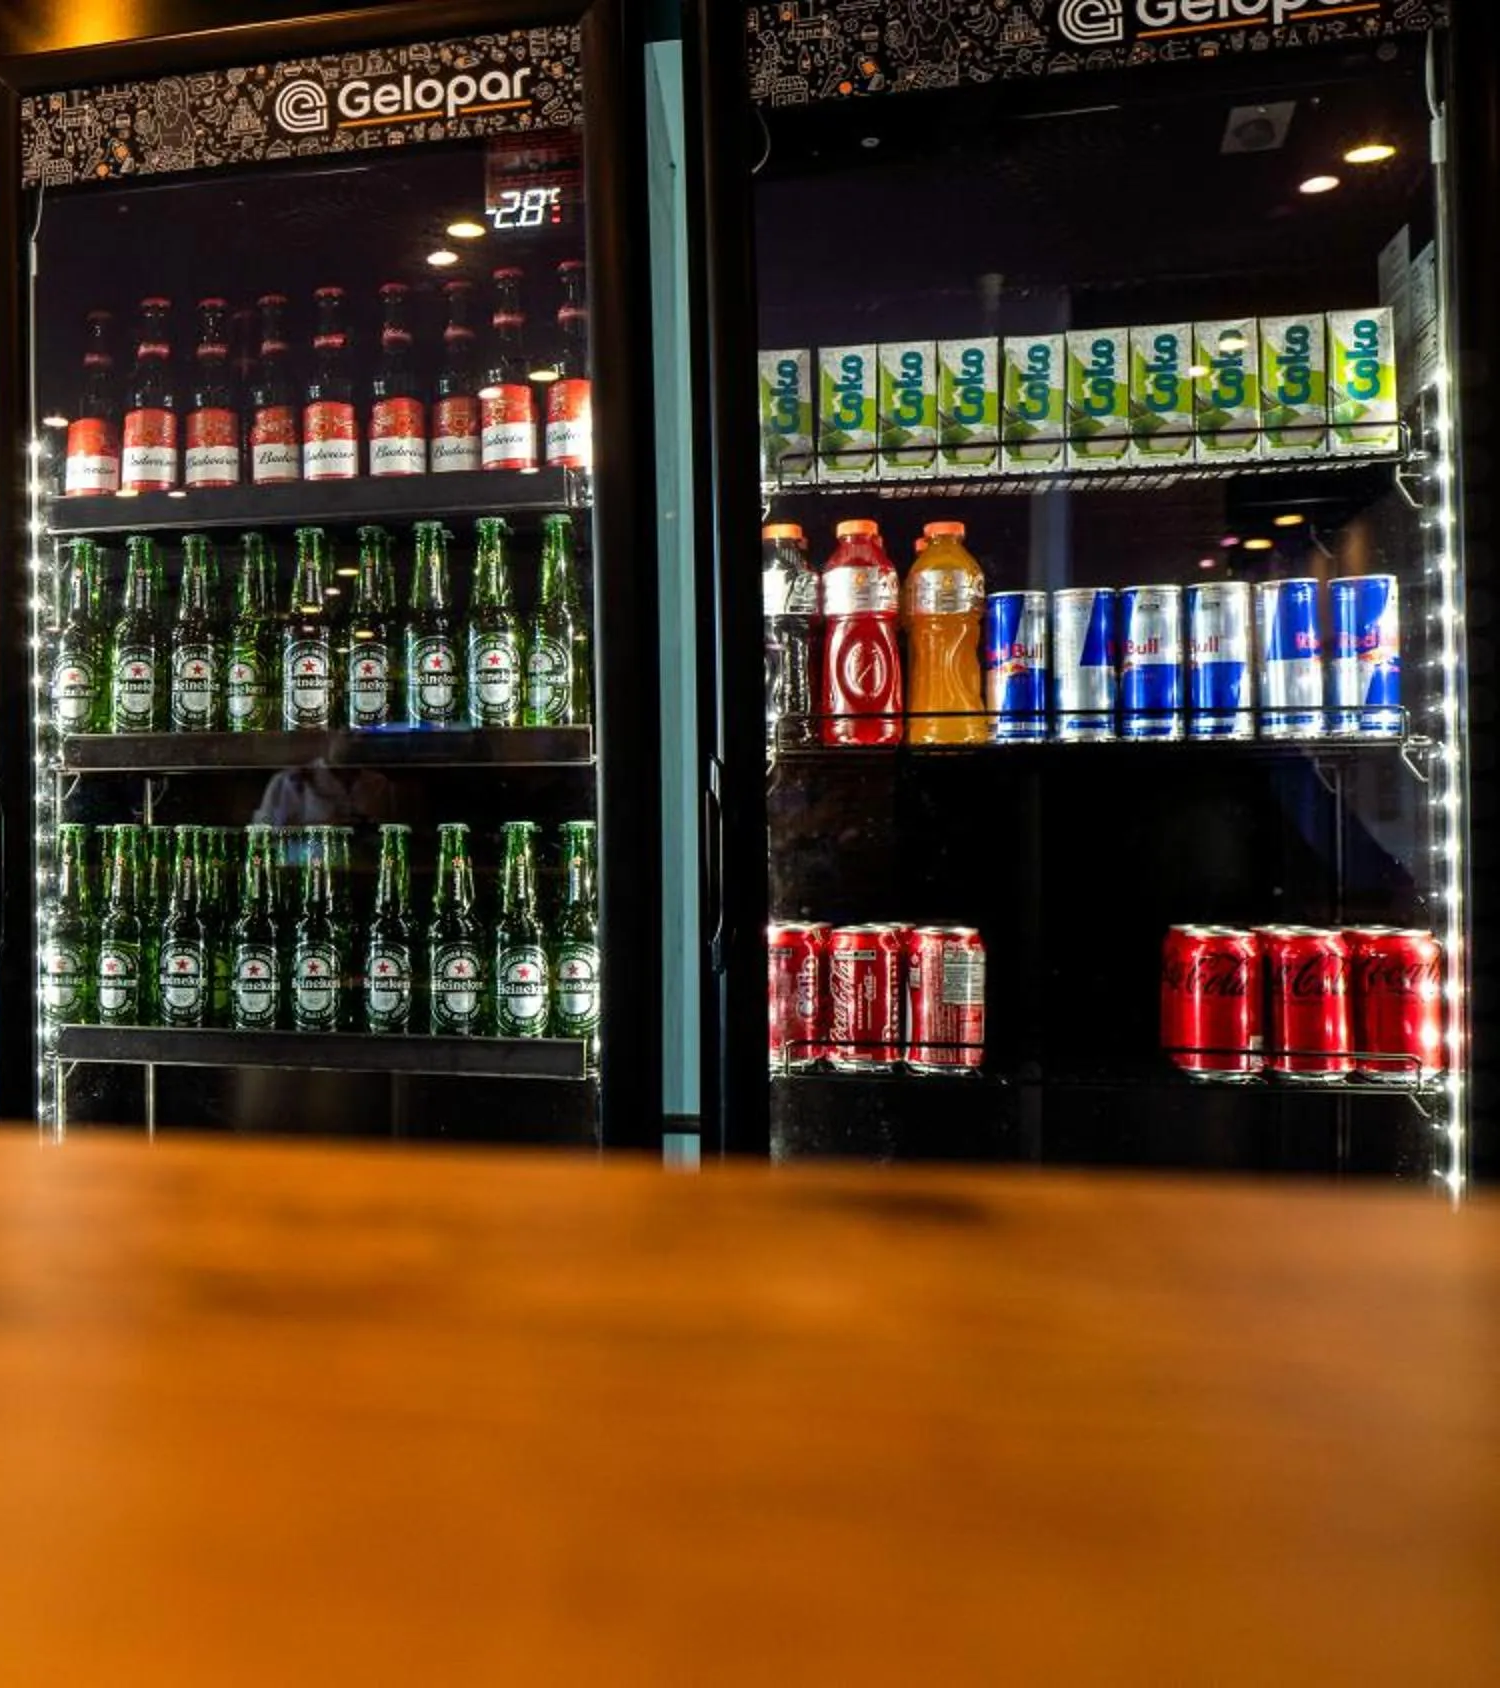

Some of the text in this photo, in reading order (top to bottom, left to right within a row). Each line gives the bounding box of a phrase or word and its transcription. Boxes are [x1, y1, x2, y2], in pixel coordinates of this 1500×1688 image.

[337, 67, 531, 118] Gelopar
[771, 359, 799, 434] Coko
[834, 354, 864, 430] Coko
[893, 351, 924, 427] Coko
[954, 348, 984, 424] Coko
[1019, 344, 1050, 421] Coko
[1084, 339, 1115, 416] Coko
[1146, 334, 1178, 413] Coko
[1277, 325, 1309, 405] Coko
[1347, 320, 1380, 401] Coko
